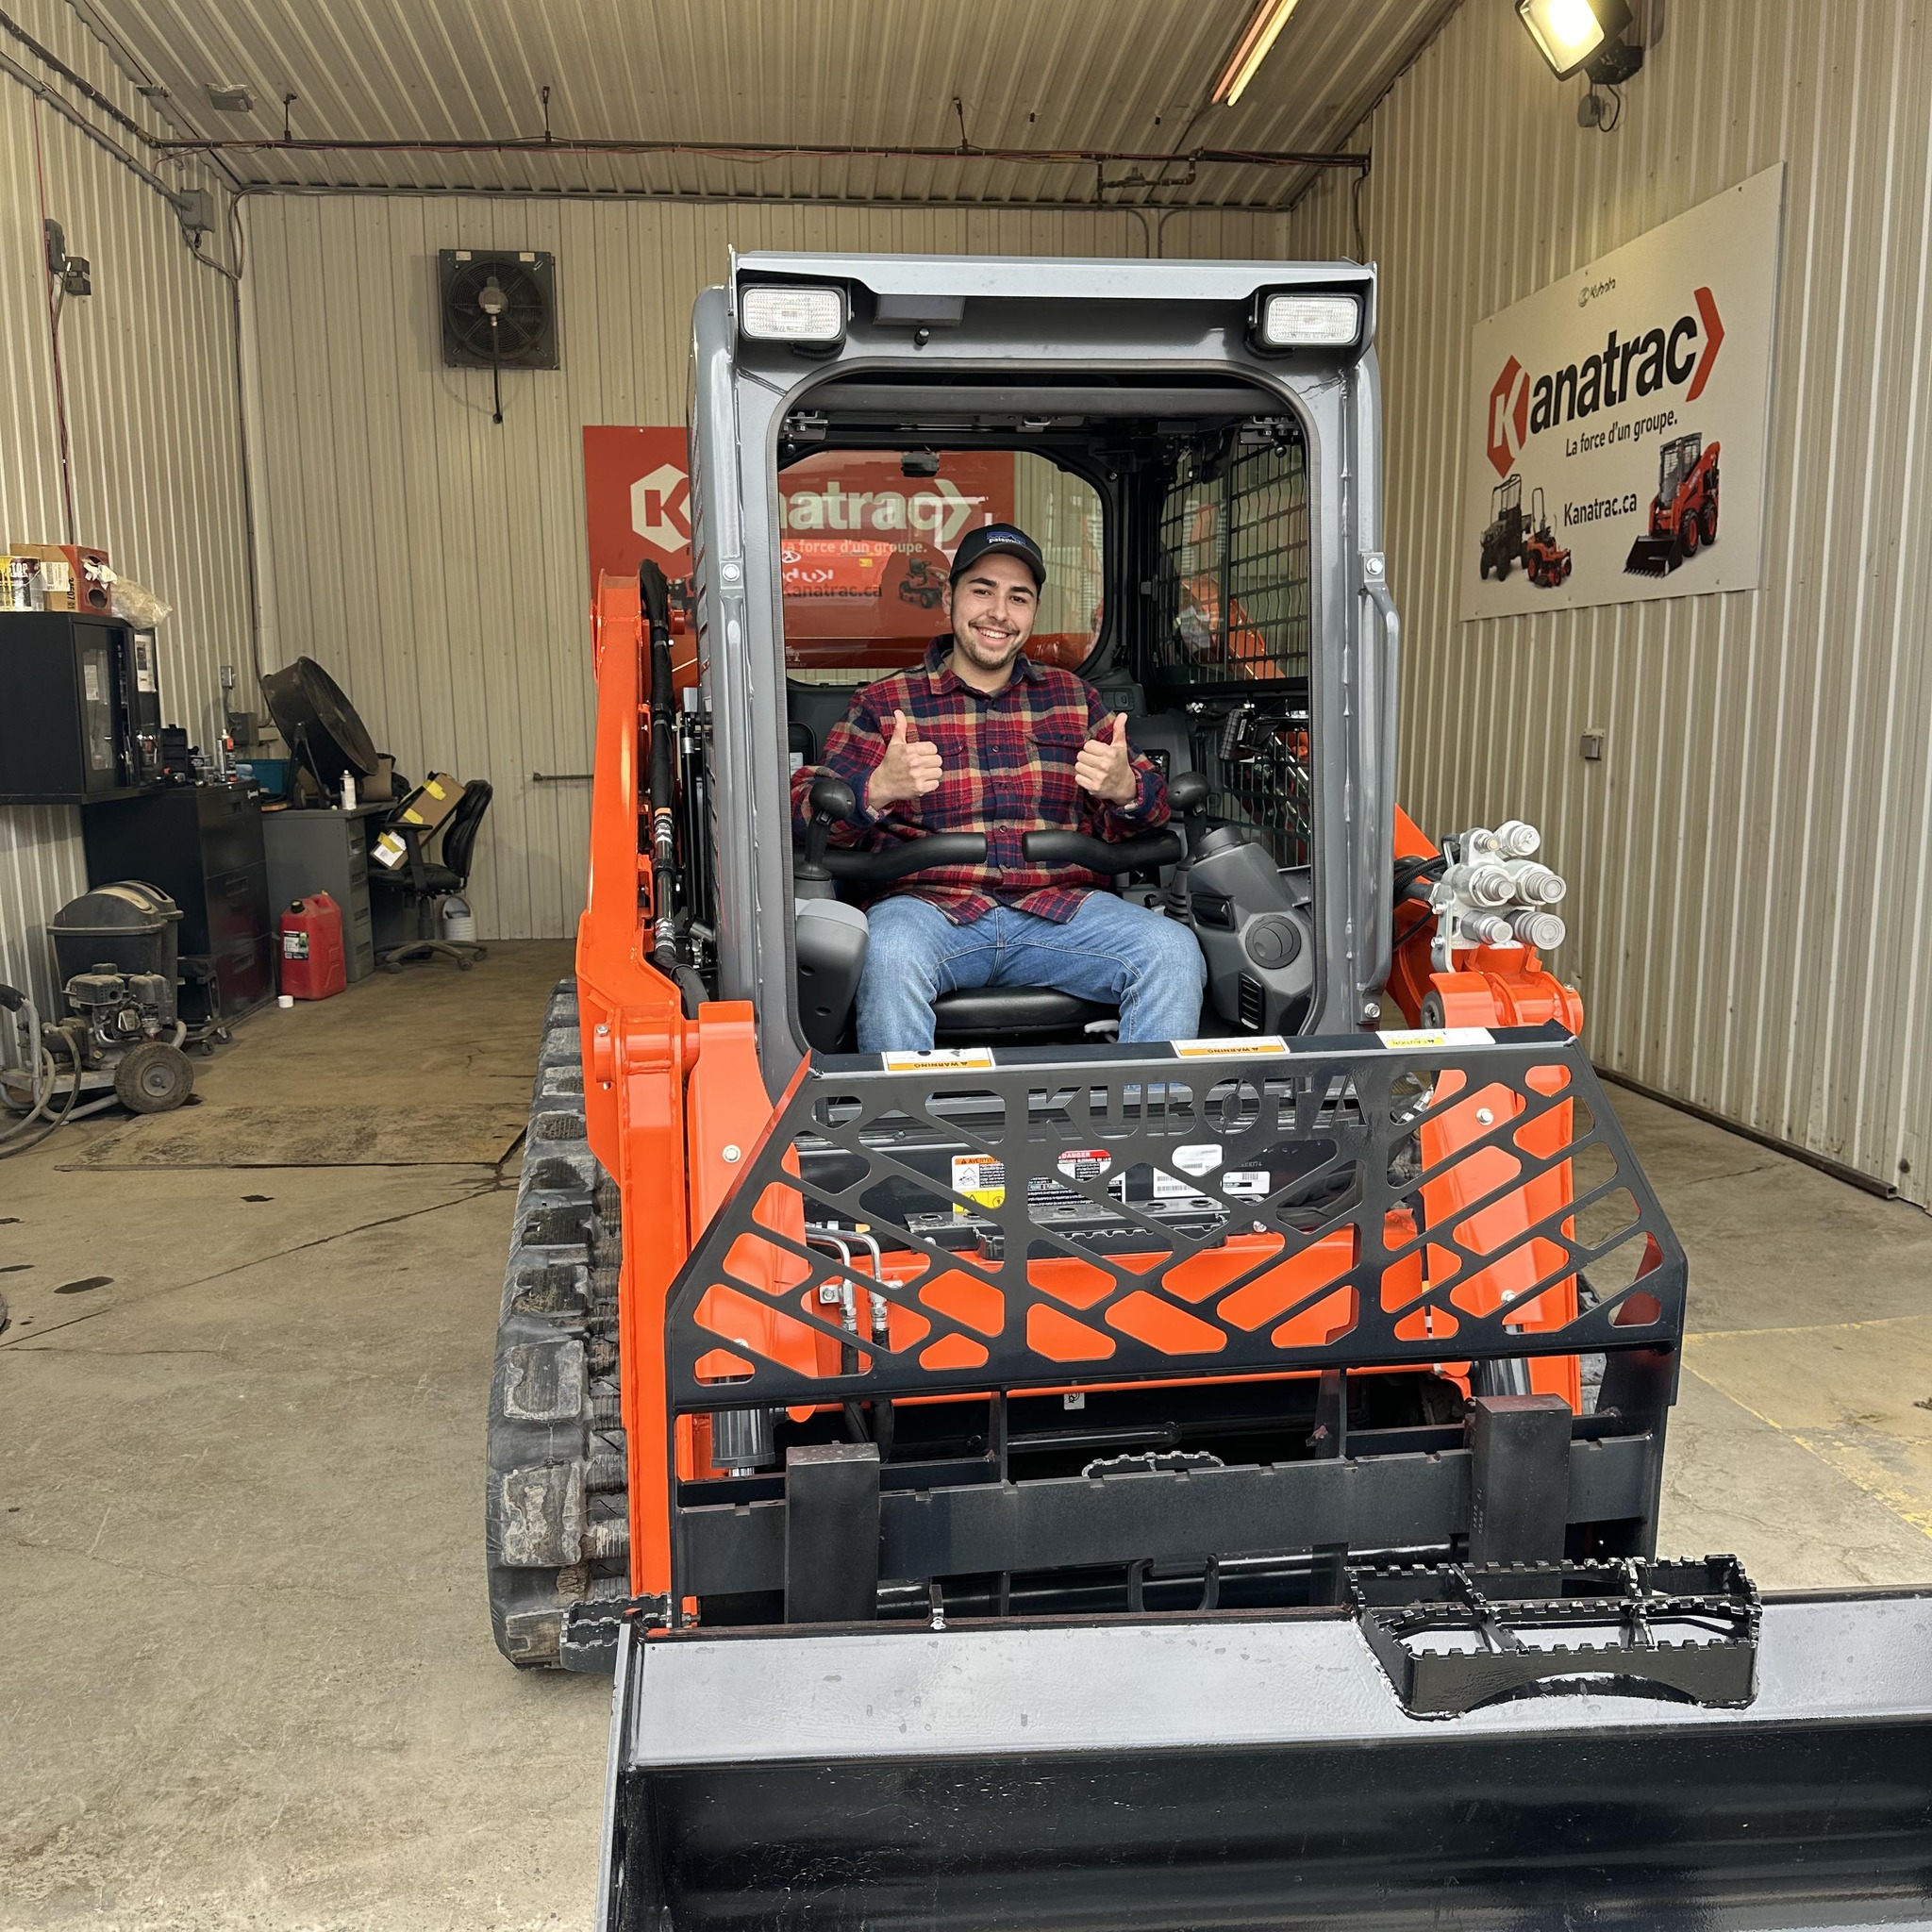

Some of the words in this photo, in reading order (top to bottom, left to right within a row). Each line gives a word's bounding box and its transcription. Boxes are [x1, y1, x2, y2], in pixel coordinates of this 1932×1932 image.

[1491, 315, 1698, 452] Kanatrac
[1566, 438, 1577, 458] La
[1580, 432, 1606, 453] force
[1608, 421, 1631, 444] d'un
[1634, 409, 1678, 441] groupe.
[1564, 492, 1638, 527] Kanatrac.ca
[799, 540, 836, 553] force
[841, 540, 870, 553] d'un
[874, 541, 927, 556] groupe.
[1027, 1074, 1368, 1142] KUBOTA
